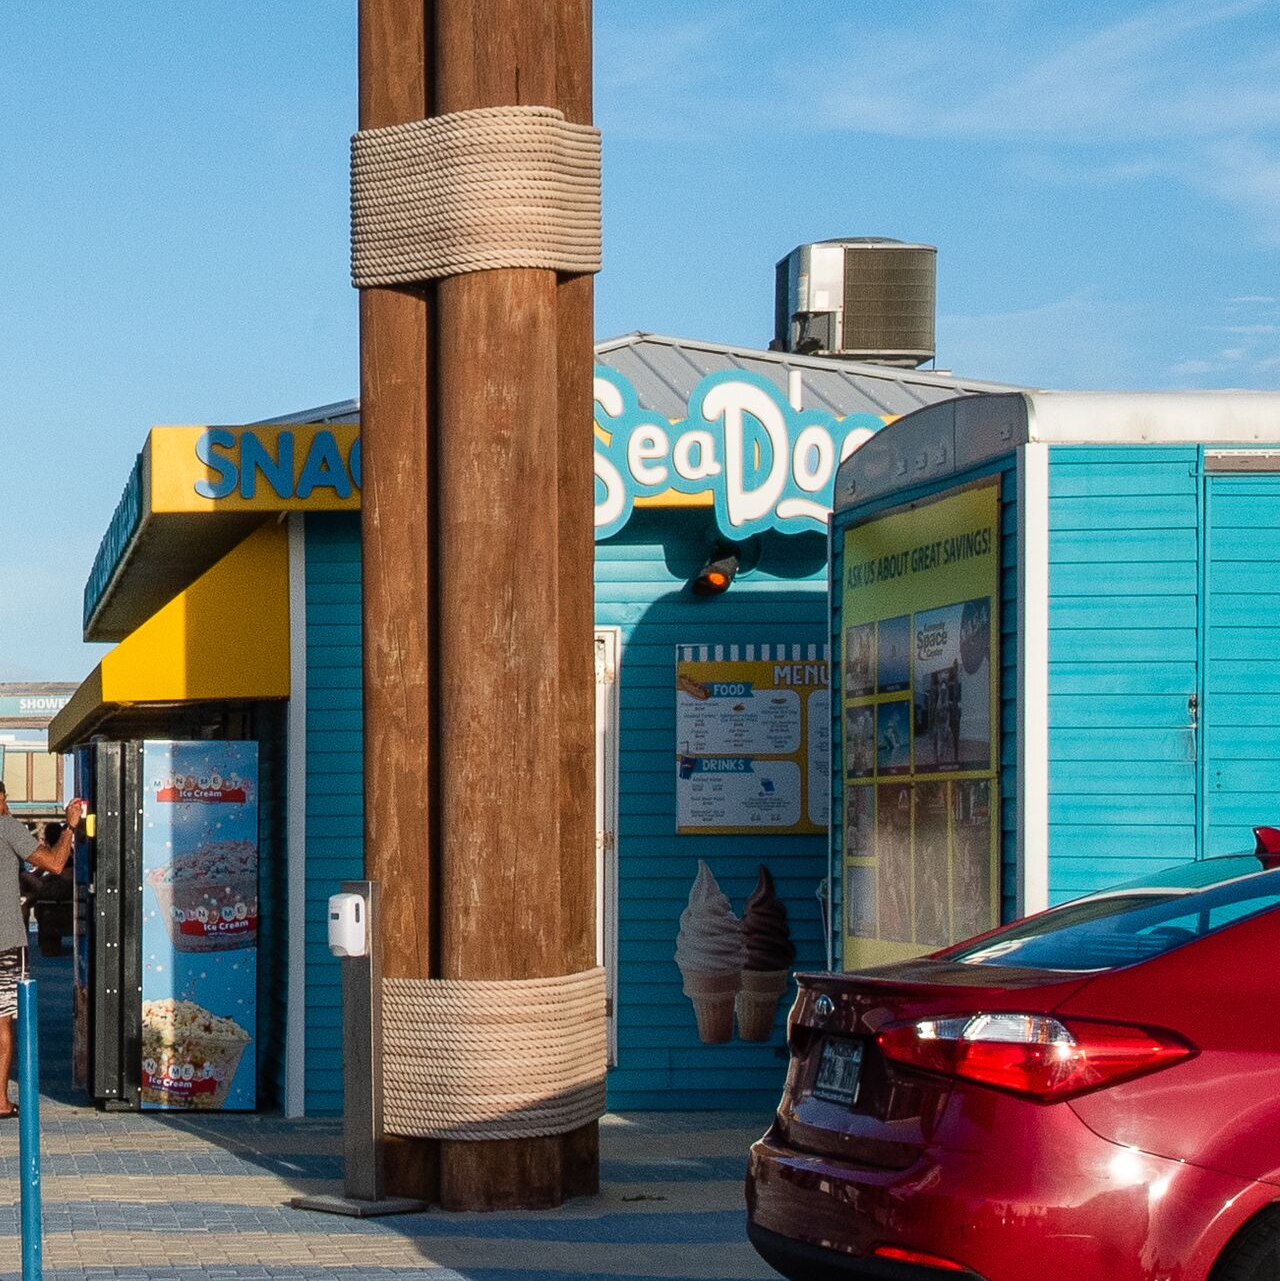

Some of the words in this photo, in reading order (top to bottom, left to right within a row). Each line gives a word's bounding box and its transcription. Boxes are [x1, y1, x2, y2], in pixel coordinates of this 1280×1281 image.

[194, 430, 361, 499] SNA
[847, 566, 862, 589] ASK
[863, 561, 877, 585] US
[877, 551, 910, 582] ABOUT
[911, 541, 940, 573] GREAT
[943, 527, 991, 565] SAVINGS!
[916, 629, 948, 650] Space
[713, 684, 745, 696] FOOD
[702, 759, 744, 771] DRINKS
[179, 789, 192, 798] Ice
[194, 789, 223, 798] Cream
[204, 923, 217, 931] Ice
[219, 920, 249, 931] Cream
[149, 1076, 162, 1085] Ice
[163, 1078, 193, 1088] Cream
